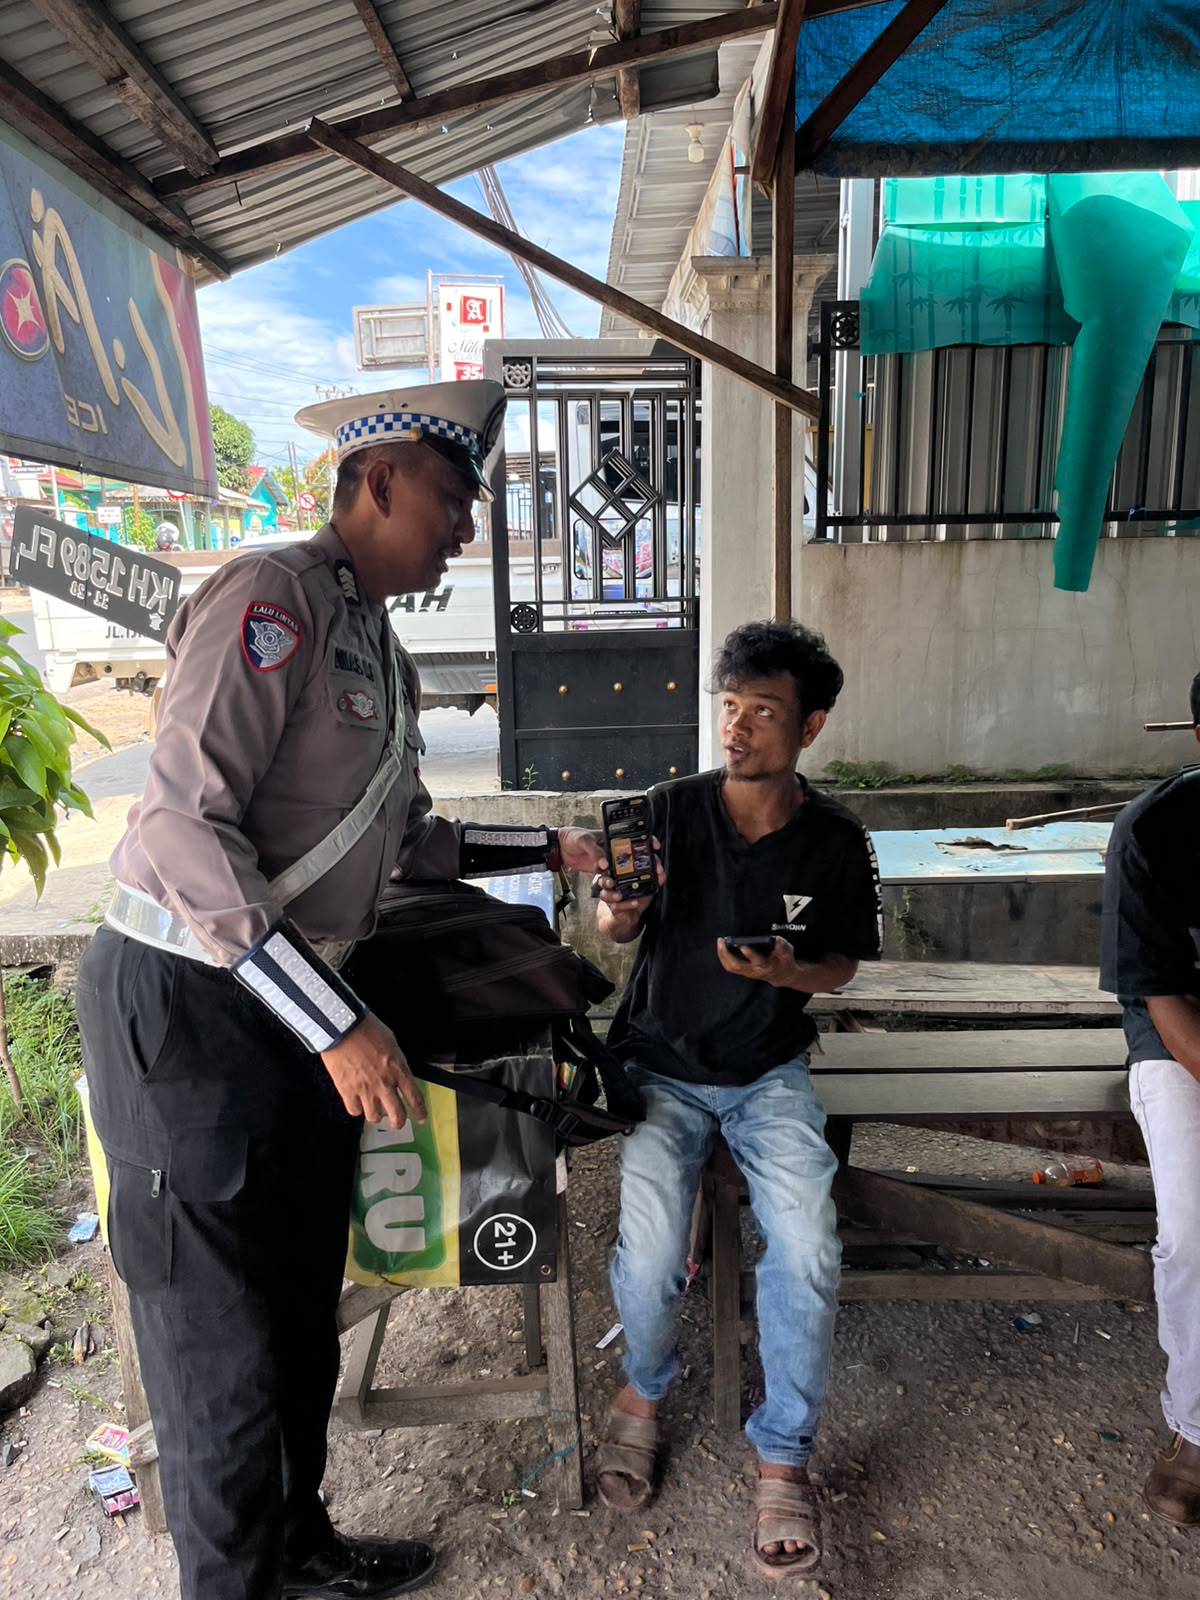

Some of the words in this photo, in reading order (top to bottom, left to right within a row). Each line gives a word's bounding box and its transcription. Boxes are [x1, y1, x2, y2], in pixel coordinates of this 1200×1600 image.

[253, 605, 275, 626] LALU
[275, 611, 299, 632] LINTAS
[493, 1221, 517, 1265] 21+
